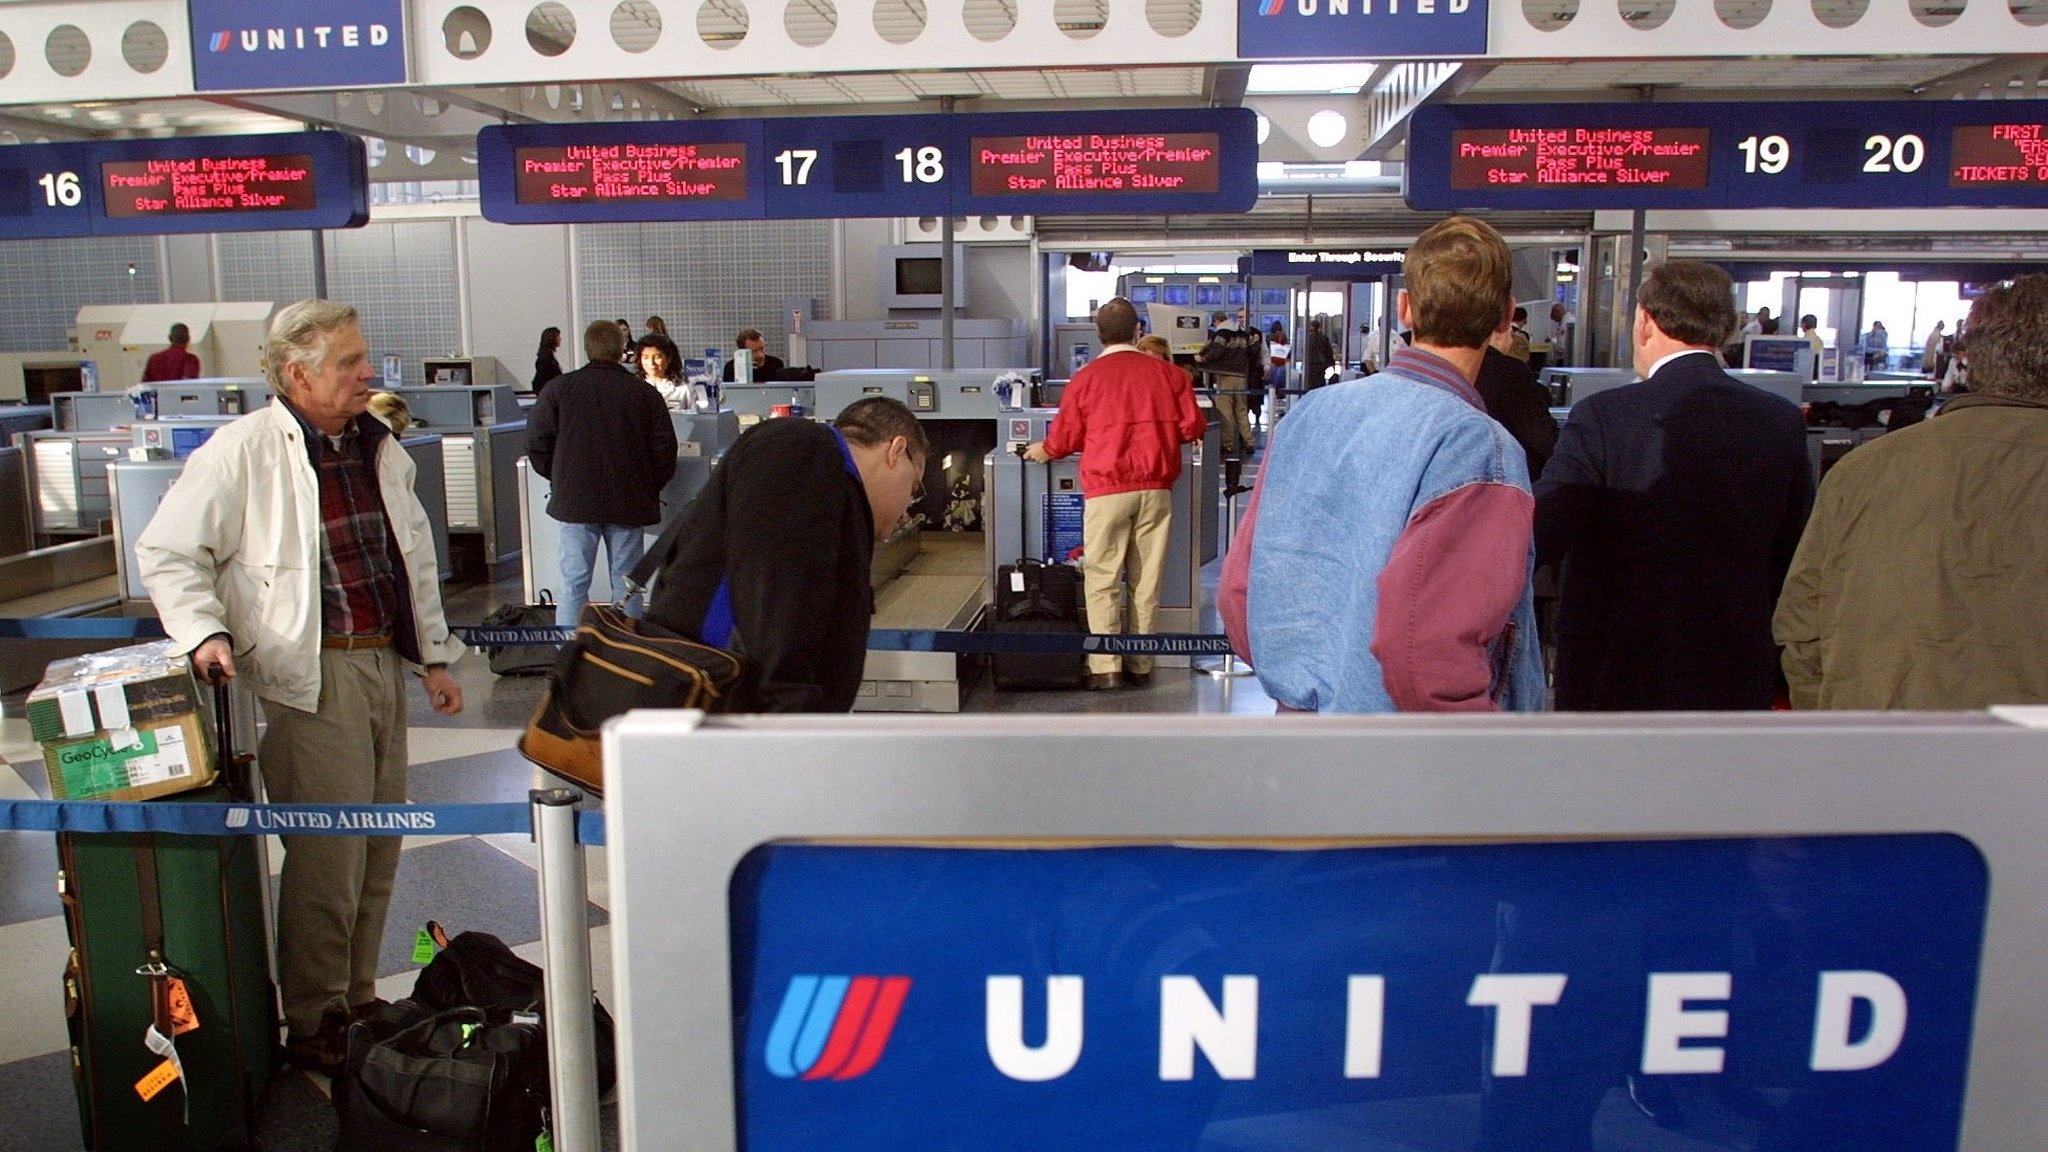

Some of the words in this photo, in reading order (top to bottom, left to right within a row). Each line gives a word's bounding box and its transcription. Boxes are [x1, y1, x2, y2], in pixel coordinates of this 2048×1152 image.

[1298, 0, 1469, 16] UNITED
[241, 25, 389, 51] UNITED
[1509, 129, 1567, 142] United
[1576, 129, 1653, 142] Business
[1993, 125, 2042, 139] FIRST
[1027, 137, 1082, 150] United
[1090, 136, 1165, 149] Business
[1461, 143, 1527, 157] Premier
[1536, 142, 1699, 156] Executive/Premier
[567, 146, 619, 160] United
[626, 144, 697, 158] Business
[981, 150, 1045, 163] Premier
[1054, 149, 1211, 162] Executive/Premier
[1738, 136, 1789, 173] 19
[1862, 134, 1924, 173] 20
[2025, 153, 2048, 166] SE
[148, 159, 195, 173] United
[202, 158, 266, 171] Business
[525, 159, 585, 173] Premier
[592, 157, 740, 171] Executive/Premier
[775, 150, 818, 185] 17
[895, 147, 944, 183] 18
[1054, 162, 1093, 175] Pass
[1102, 162, 1137, 174] Plus
[1536, 156, 1577, 169] Pass
[1586, 156, 1623, 169] Plus
[110, 172, 165, 187] Premier
[172, 169, 306, 185] Executive/Premier
[592, 170, 629, 183] Pass
[637, 170, 671, 182] Plus
[1008, 175, 1046, 189] Star
[1056, 175, 1123, 188] Alliance
[1132, 174, 1184, 188] Silver
[1488, 169, 1528, 183] Star
[1538, 169, 1607, 183] Alliance
[1616, 169, 1670, 183] Silver
[38, 171, 82, 207] 16
[173, 184, 206, 196] Pass
[213, 183, 245, 195] Plus
[551, 184, 587, 197] Star
[595, 182, 659, 196] Alliance
[666, 181, 715, 195] Silver
[135, 197, 168, 211] Star
[175, 195, 233, 208] Alliance
[241, 193, 285, 207] Silver
[1288, 252, 1317, 262] Enter
[1319, 252, 1361, 264] Through
[469, 630, 519, 642] UNITED
[1104, 638, 1158, 651] UNITED
[1160, 638, 1230, 651] AIRLINES
[255, 809, 332, 829] UNITED
[337, 810, 436, 829] AIRLINES
[985, 971, 1907, 1083] UNITED
